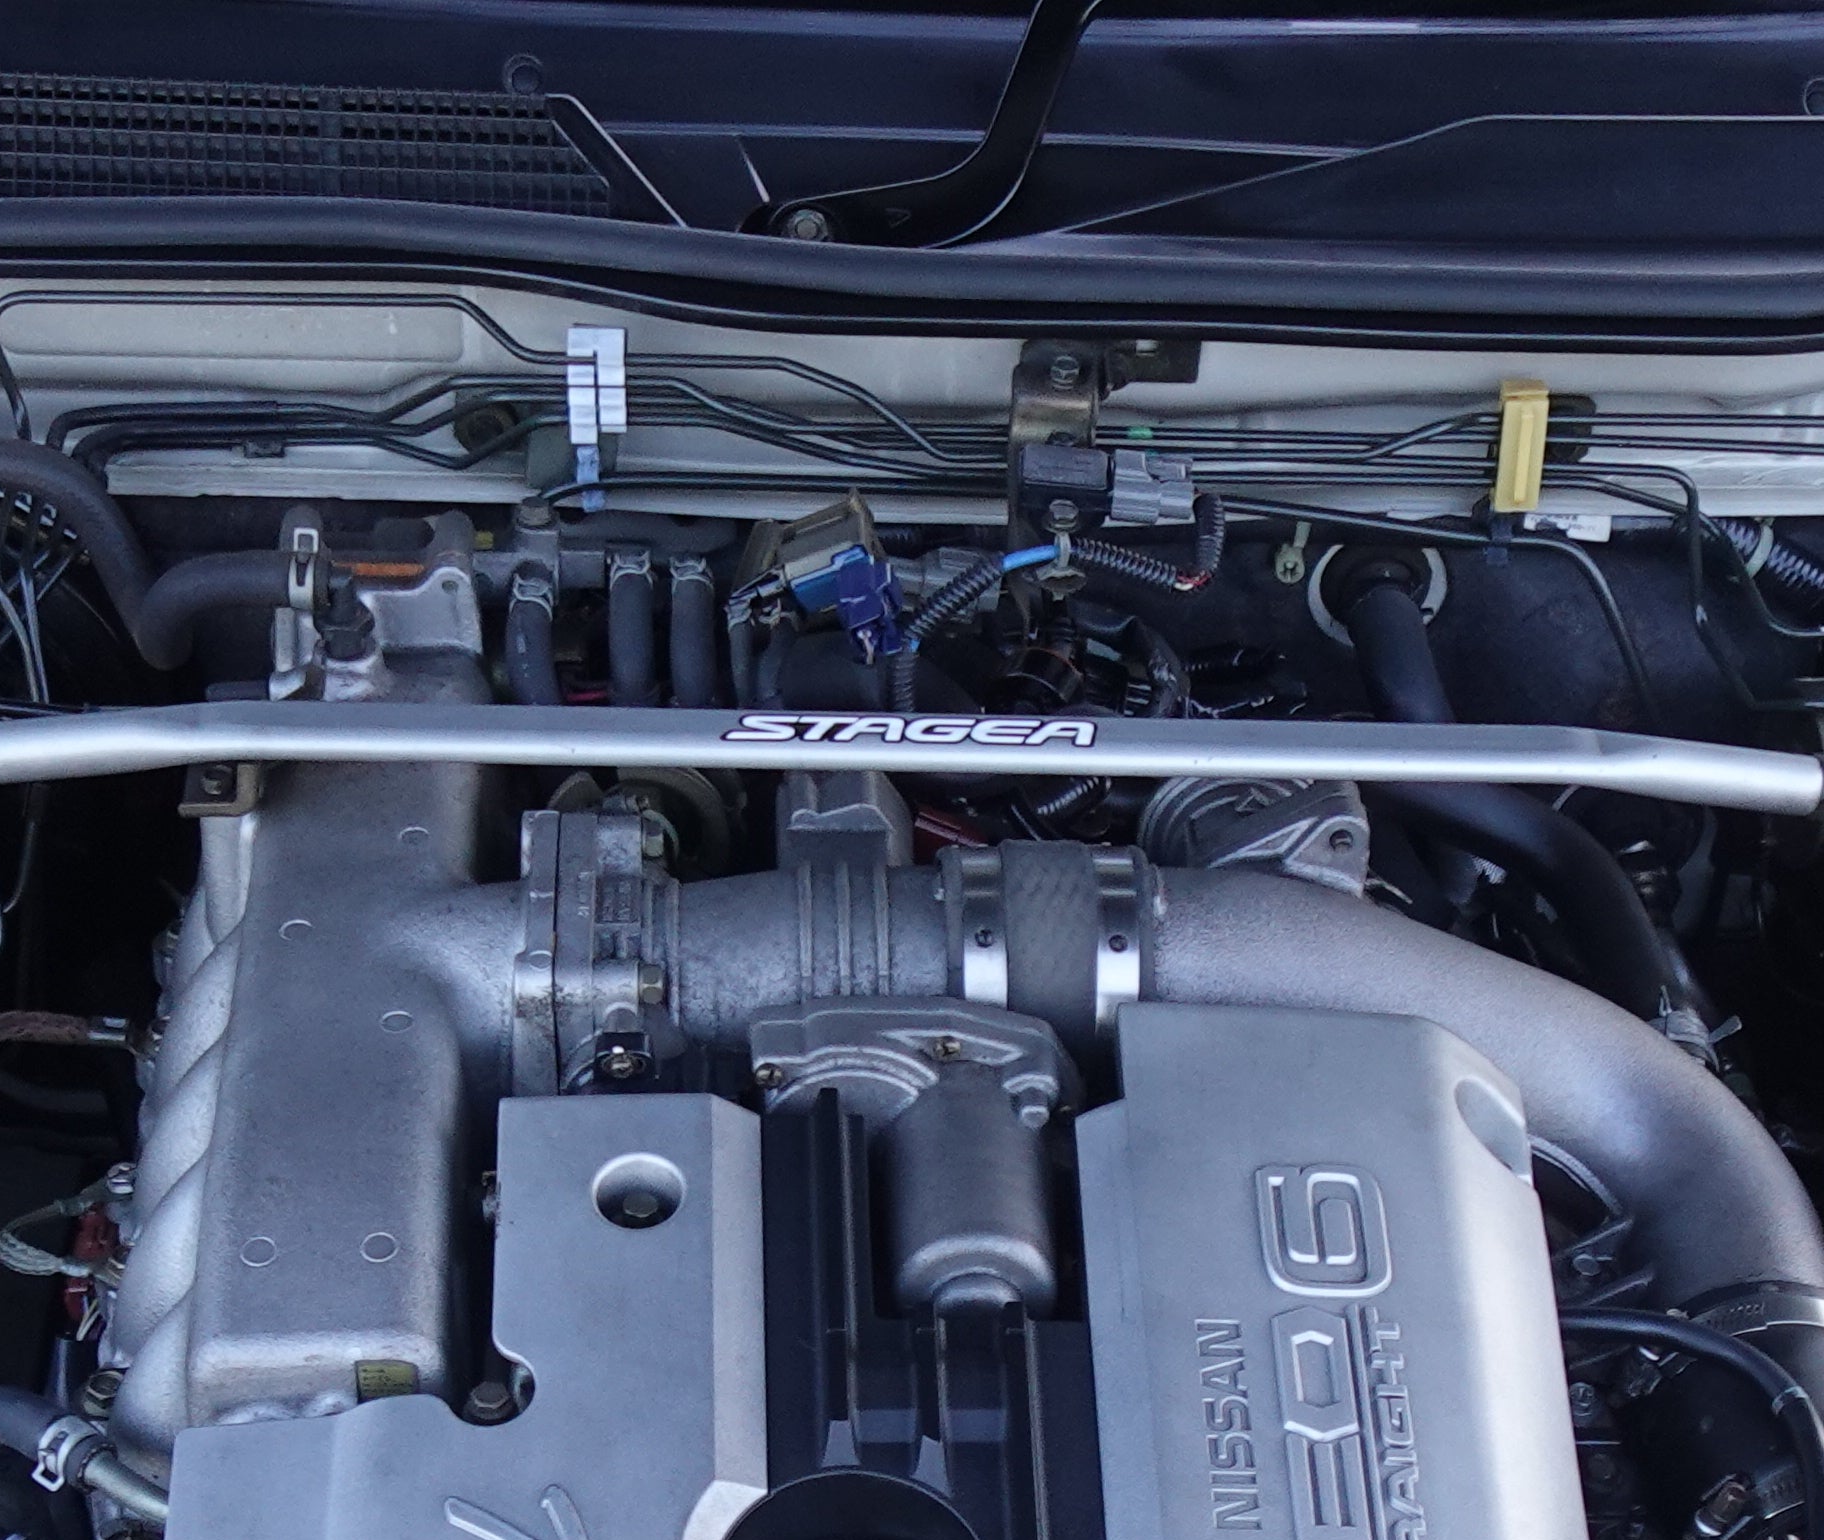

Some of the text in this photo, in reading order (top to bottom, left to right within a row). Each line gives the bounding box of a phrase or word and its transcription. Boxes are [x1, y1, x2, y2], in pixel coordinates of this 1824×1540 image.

[722, 715, 1096, 748] STAGEA
[1253, 1162, 1393, 1298] 6
[1194, 1317, 1263, 1532] NISSAN
